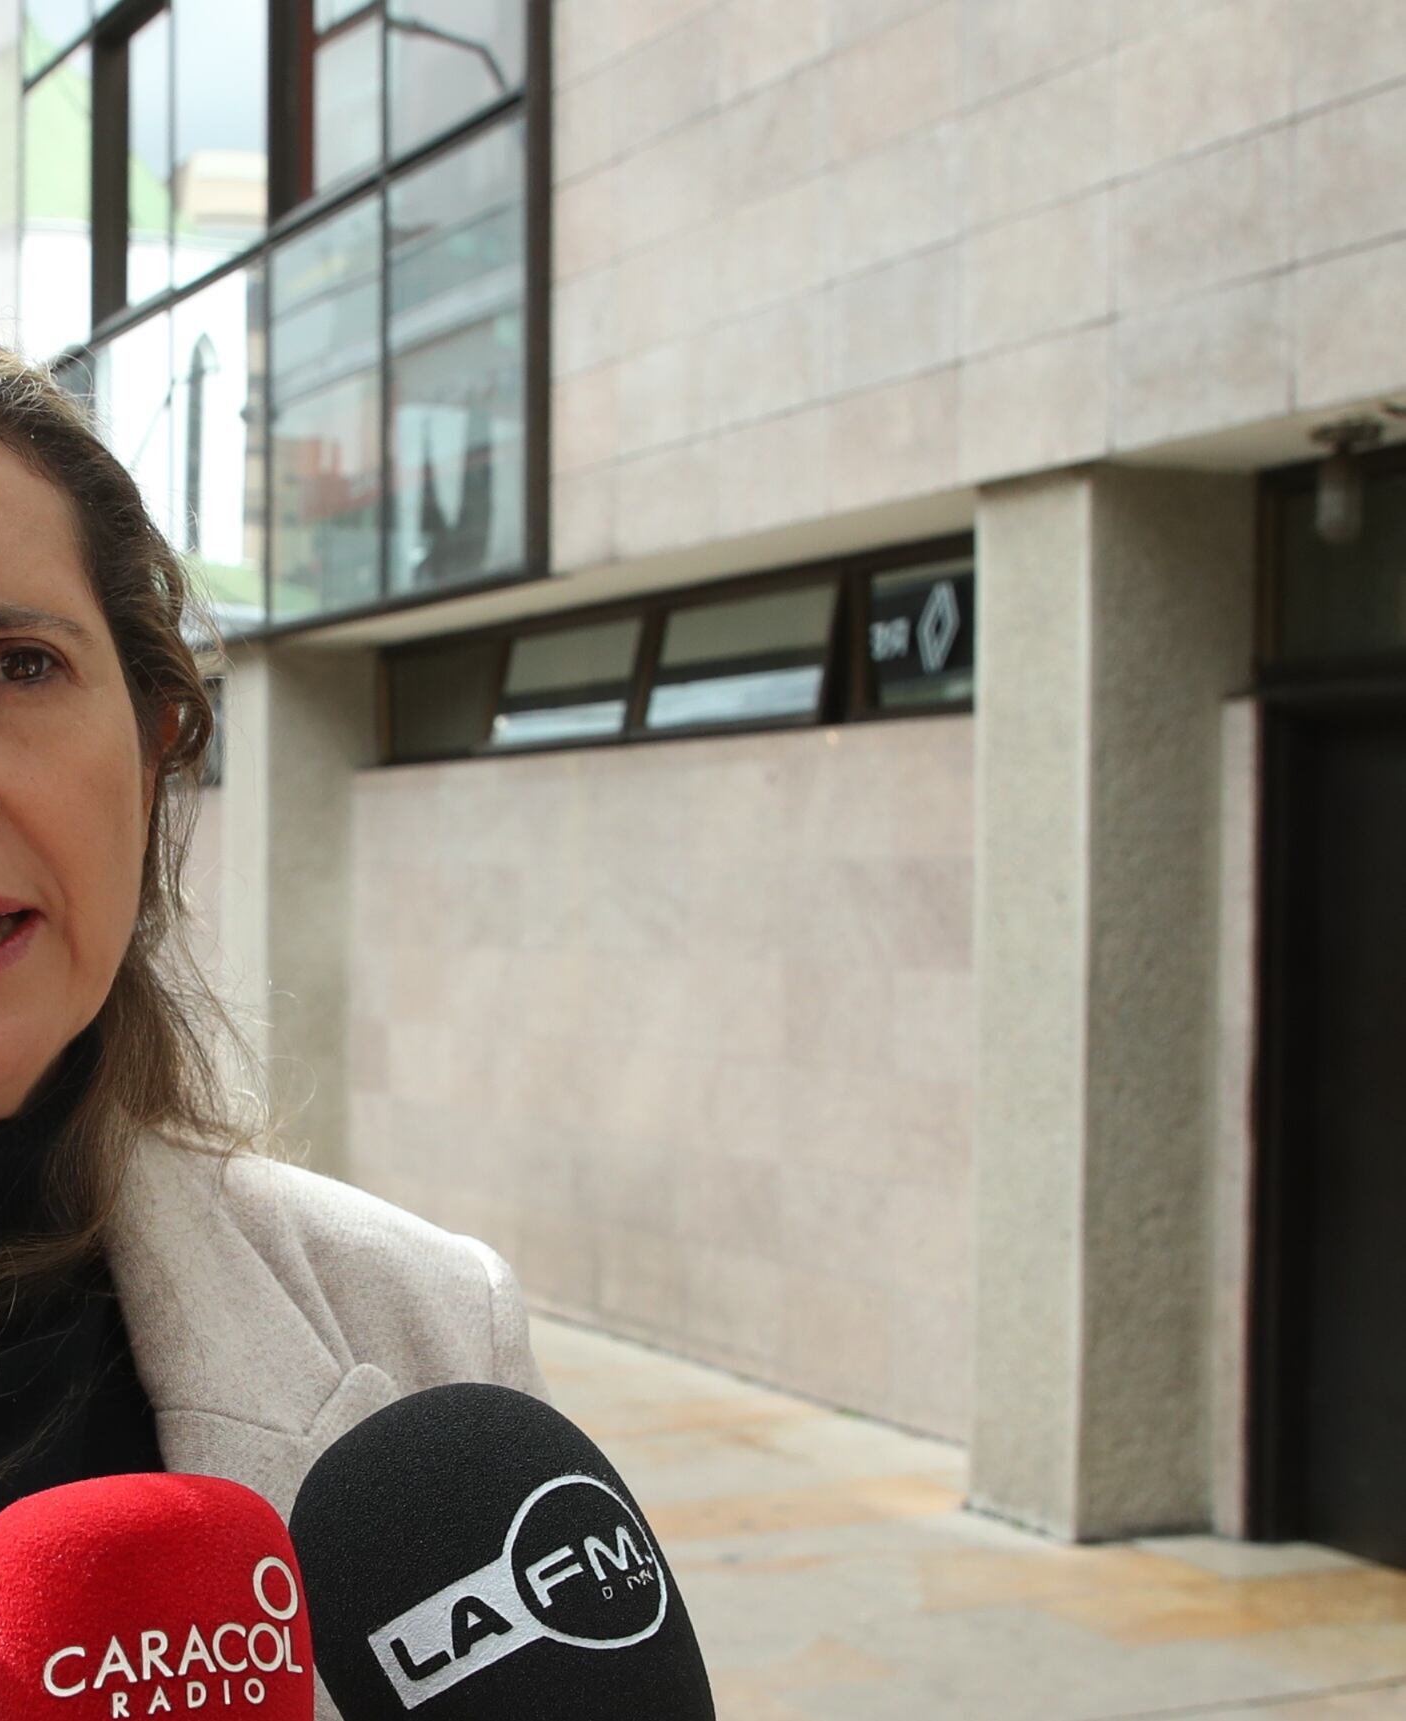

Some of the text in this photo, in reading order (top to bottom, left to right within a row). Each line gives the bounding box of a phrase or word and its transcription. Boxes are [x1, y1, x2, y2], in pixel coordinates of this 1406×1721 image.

[43, 1622, 303, 1698] CARACOL
[390, 1595, 513, 1681] LA
[112, 1678, 265, 1719] RADIO
